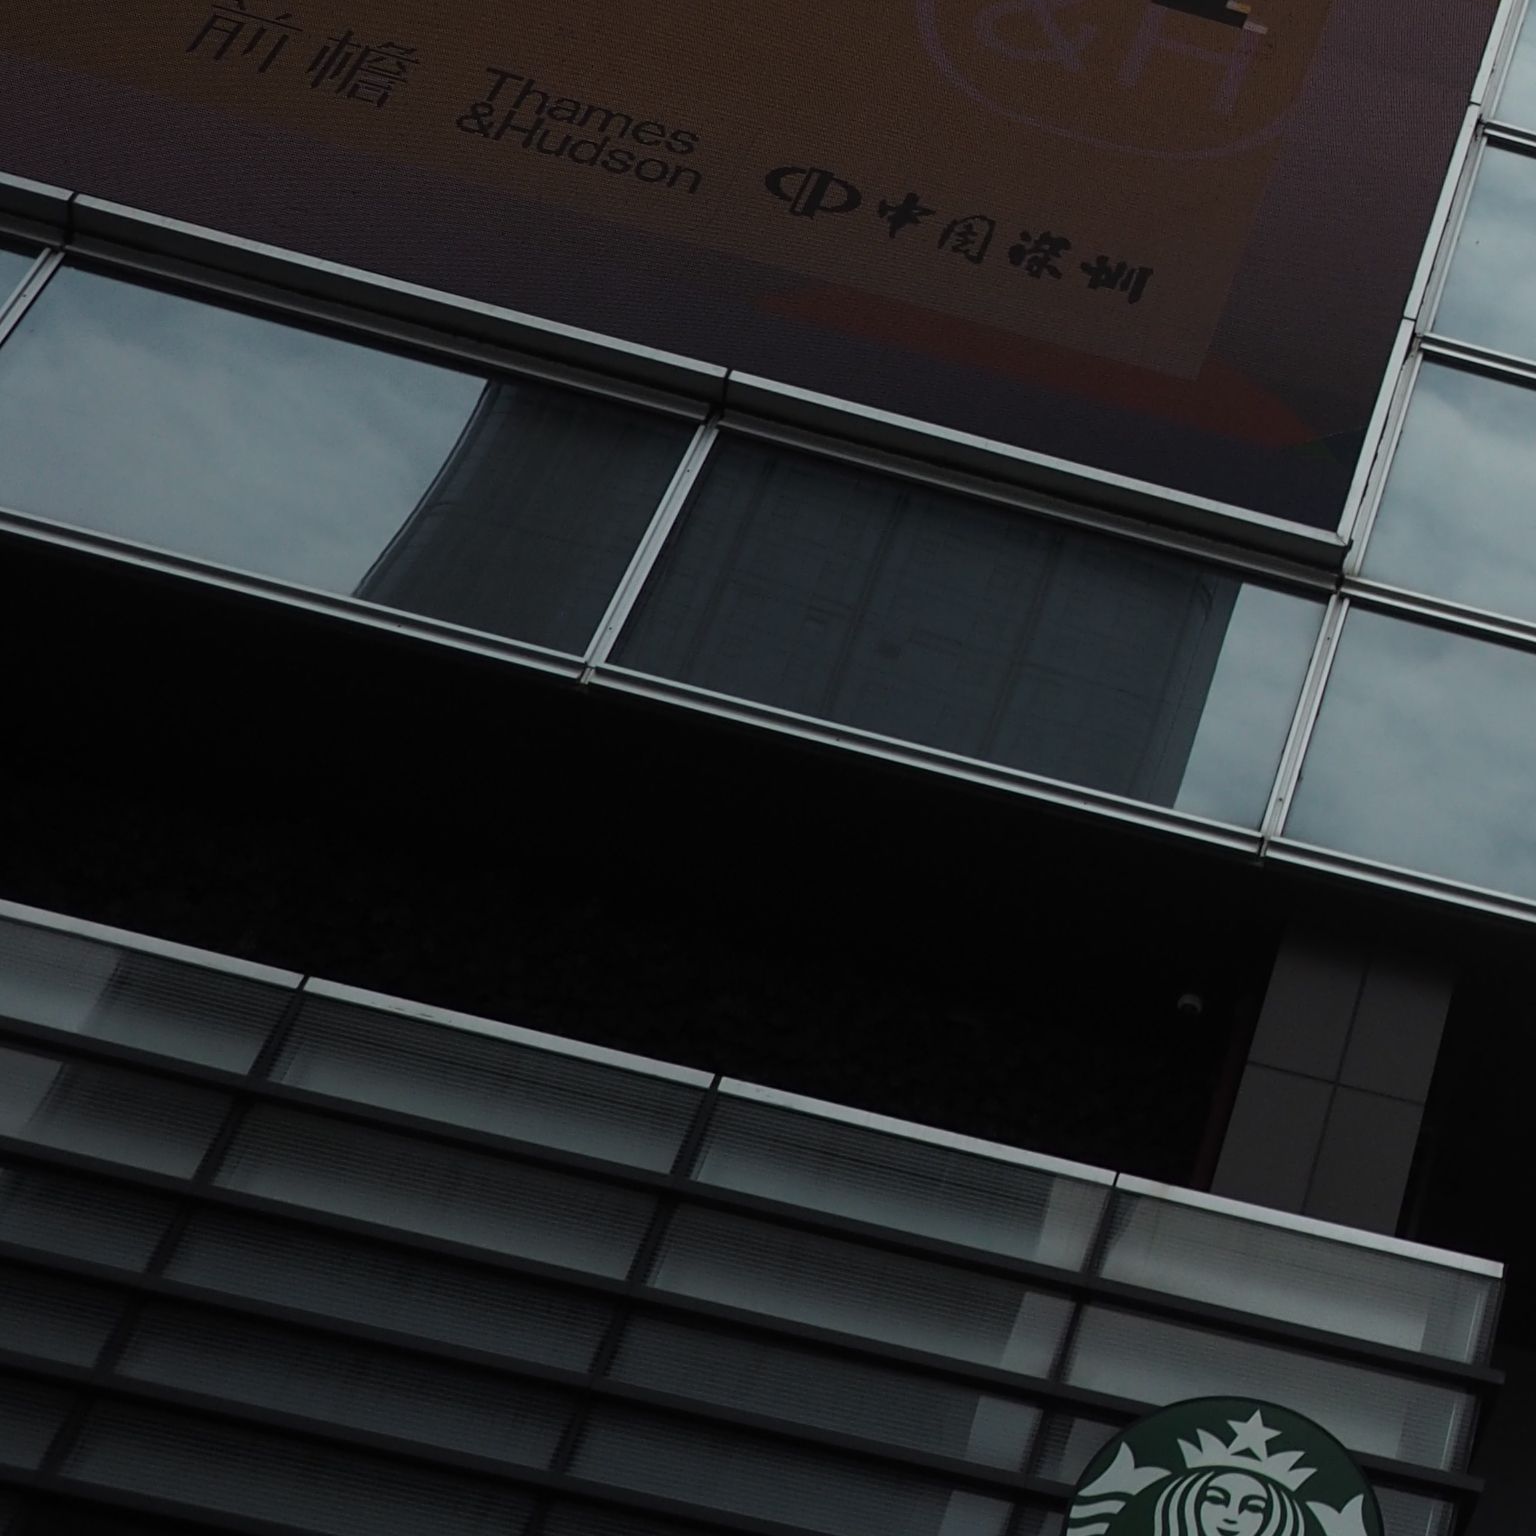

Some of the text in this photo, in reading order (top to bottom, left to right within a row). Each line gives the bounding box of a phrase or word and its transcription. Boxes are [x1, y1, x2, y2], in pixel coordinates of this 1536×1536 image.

[455, 102, 702, 194] &Hudson
[485, 67, 699, 155] Thames
[877, 192, 1153, 304] 中国深圳
